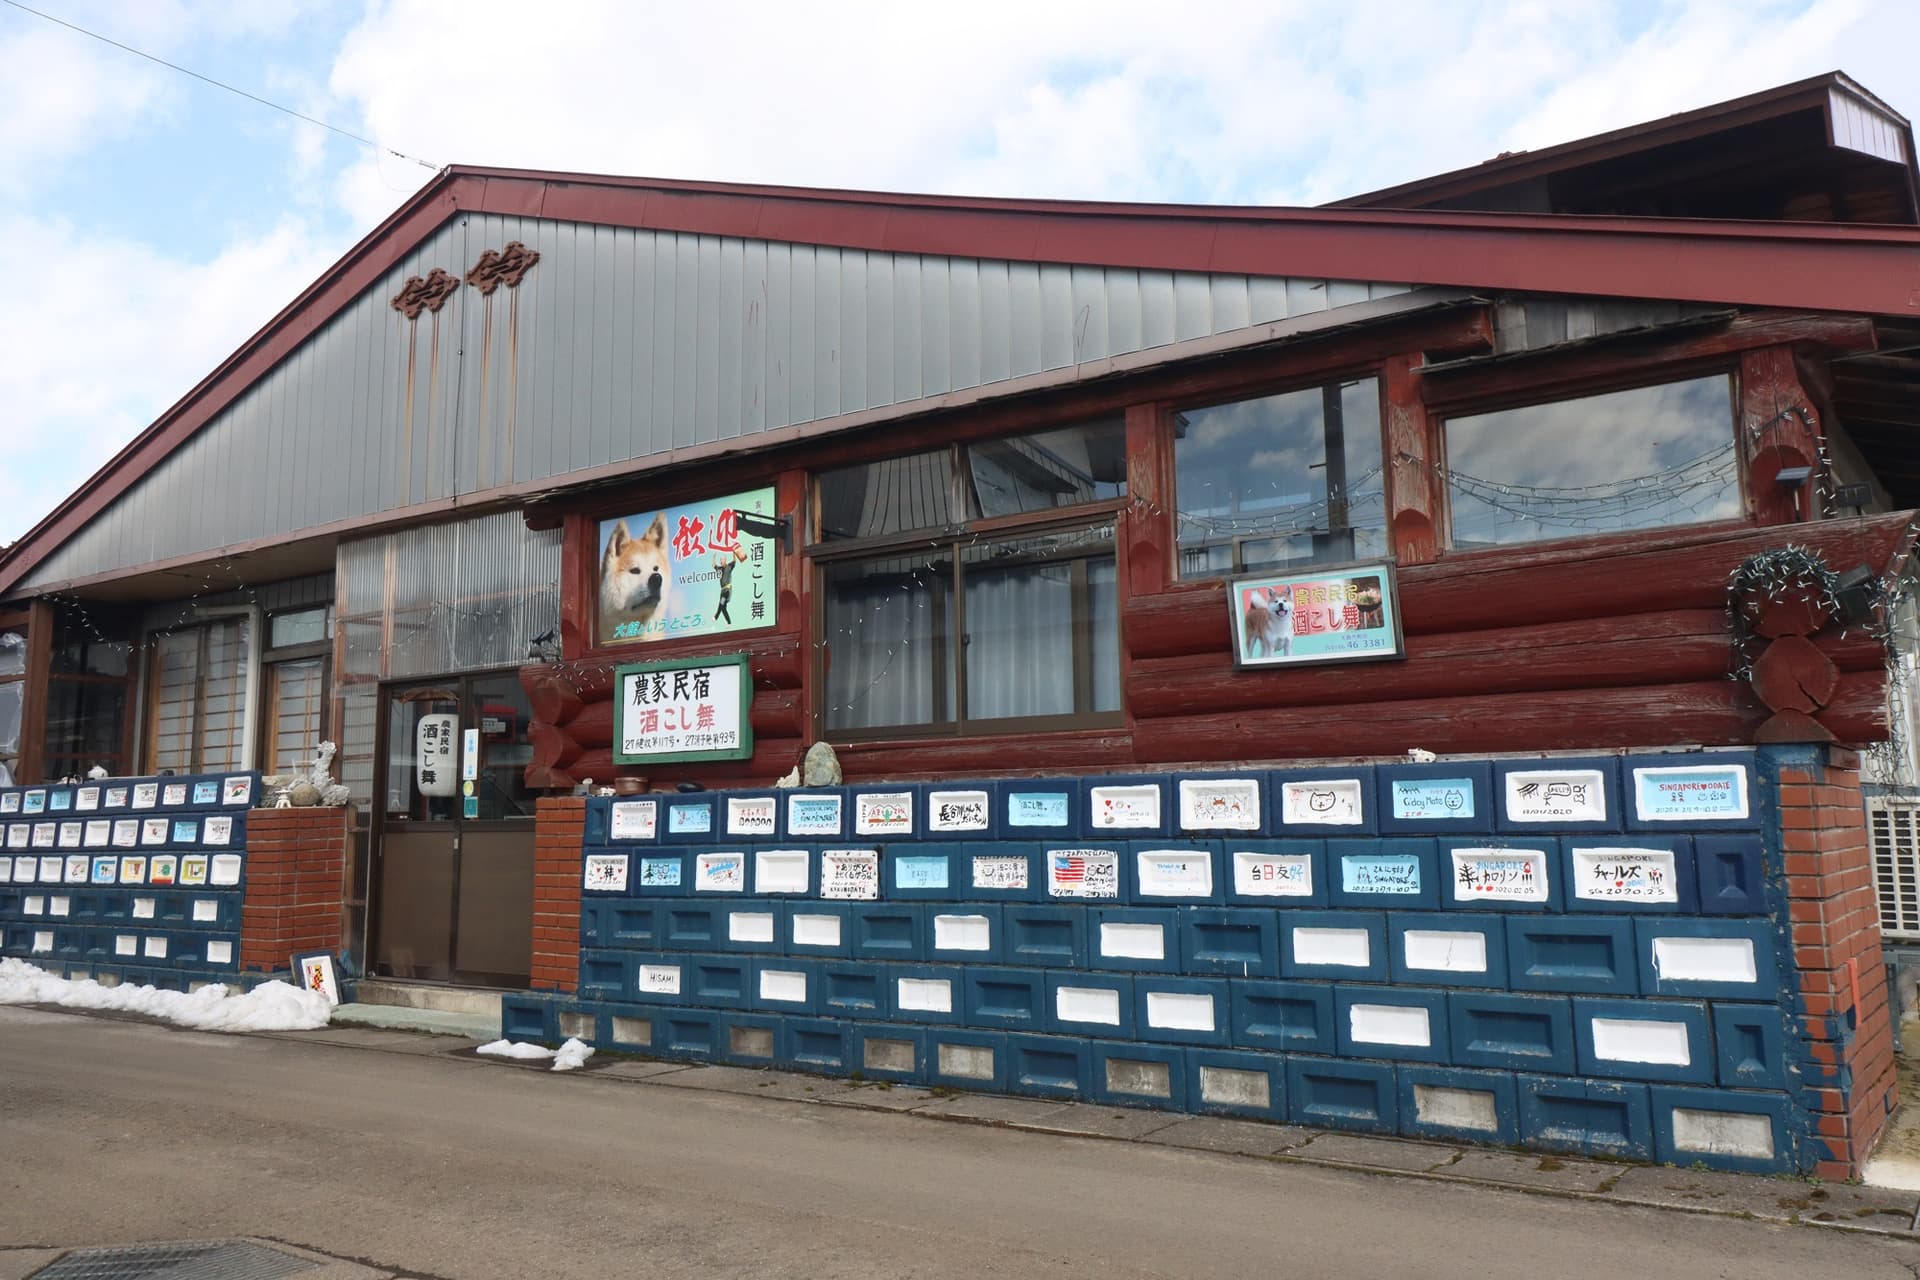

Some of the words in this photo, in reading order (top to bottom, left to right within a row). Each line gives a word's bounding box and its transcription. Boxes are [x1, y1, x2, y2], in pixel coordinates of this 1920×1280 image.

[672, 508, 740, 560] 歓迎
[679, 569, 723, 585] welcome
[750, 541, 765, 621] 酒こし舞
[1295, 584, 1359, 607] 農家民宿
[1292, 604, 1360, 635] 酒こし舞
[632, 669, 711, 706] 農家民宿
[640, 703, 716, 735] 酒こし舞
[440, 719, 451, 755] 農家民宿
[421, 723, 439, 785] 酒こし舞
[1251, 863, 1303, 882] 台日友好
[1593, 864, 1642, 881] チャールズ
